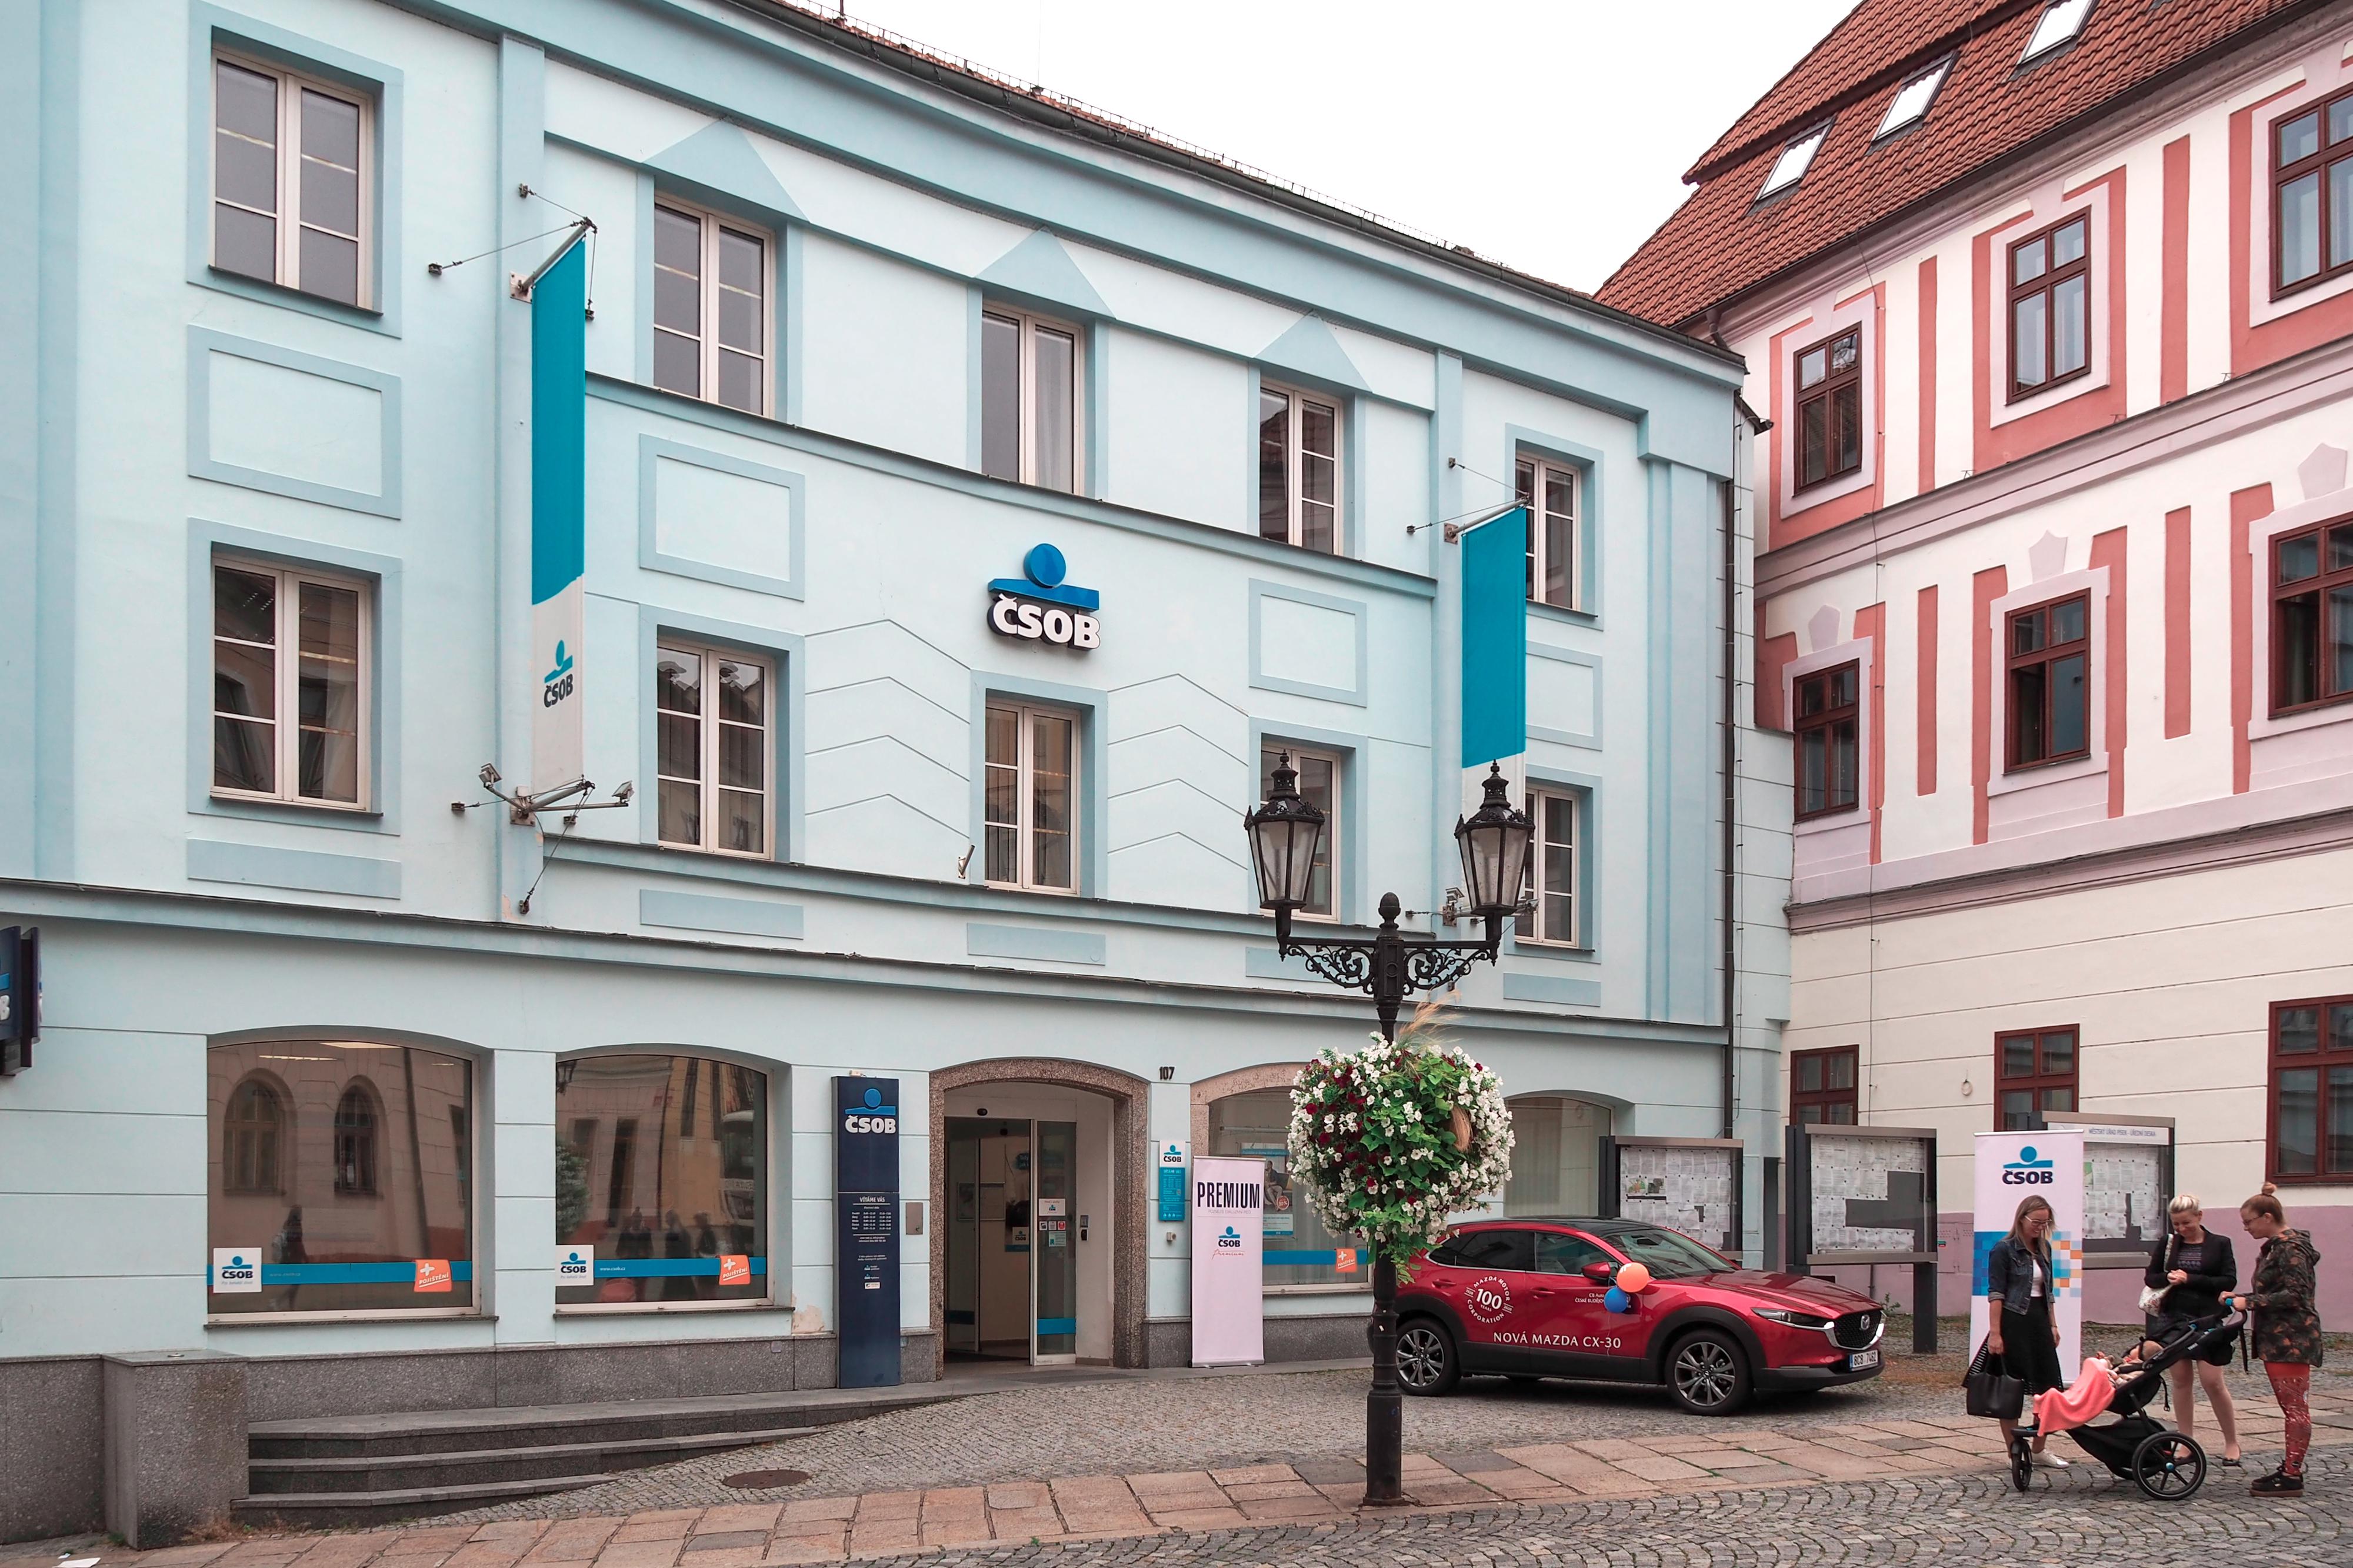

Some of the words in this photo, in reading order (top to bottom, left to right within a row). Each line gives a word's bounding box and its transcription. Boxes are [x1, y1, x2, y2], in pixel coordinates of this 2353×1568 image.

[988, 593, 1101, 649] ČSOB
[544, 673, 573, 708] ČSOB
[1159, 1066, 1175, 1080] 107
[845, 1115, 896, 1134] ČSOB
[2002, 1170, 2053, 1185] ČSOB
[1197, 1182, 1260, 1209] PREMIUM
[1218, 1239, 1241, 1247] ČSOB
[222, 1269, 254, 1279] ČSOB
[419, 1272, 449, 1285] POJIŠTĚNÍ
[561, 1265, 586, 1273] ČSOB
[722, 1266, 748, 1278] POJIŠTĚNÍ
[1473, 1276, 1497, 1288] MAZDA
[1498, 1278, 1510, 1302] MOTOR
[1476, 1288, 1502, 1309] 100
[1467, 1299, 1505, 1324] CORPORATION
[1494, 1330, 1528, 1344] NOVÁ
[1532, 1333, 1578, 1347] MAZDA
[1583, 1336, 1622, 1349] CX-30
